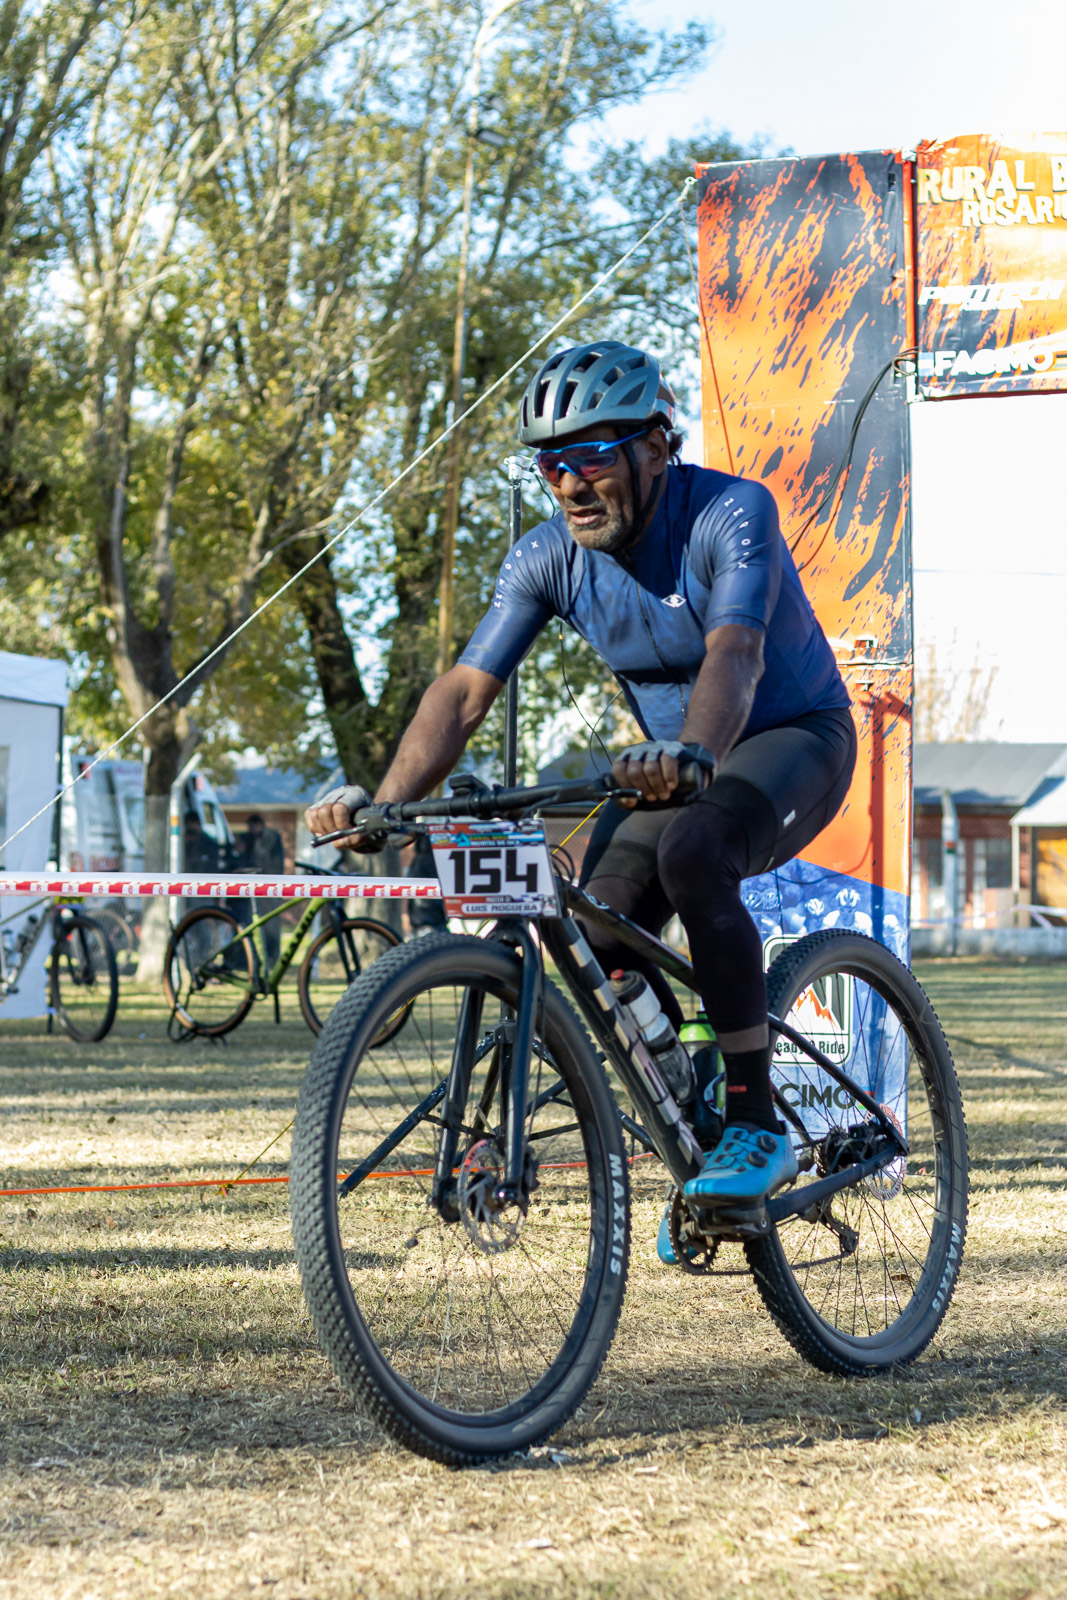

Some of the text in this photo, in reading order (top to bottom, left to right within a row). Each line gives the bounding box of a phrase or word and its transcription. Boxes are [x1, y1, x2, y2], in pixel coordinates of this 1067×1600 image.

[917, 159, 1035, 204] RURAL
[448, 849, 538, 894] 154
[819, 1040, 845, 1054] Ride
[608, 1152, 626, 1276] MAXXIS
[931, 1222, 961, 1313] MAXXIS
